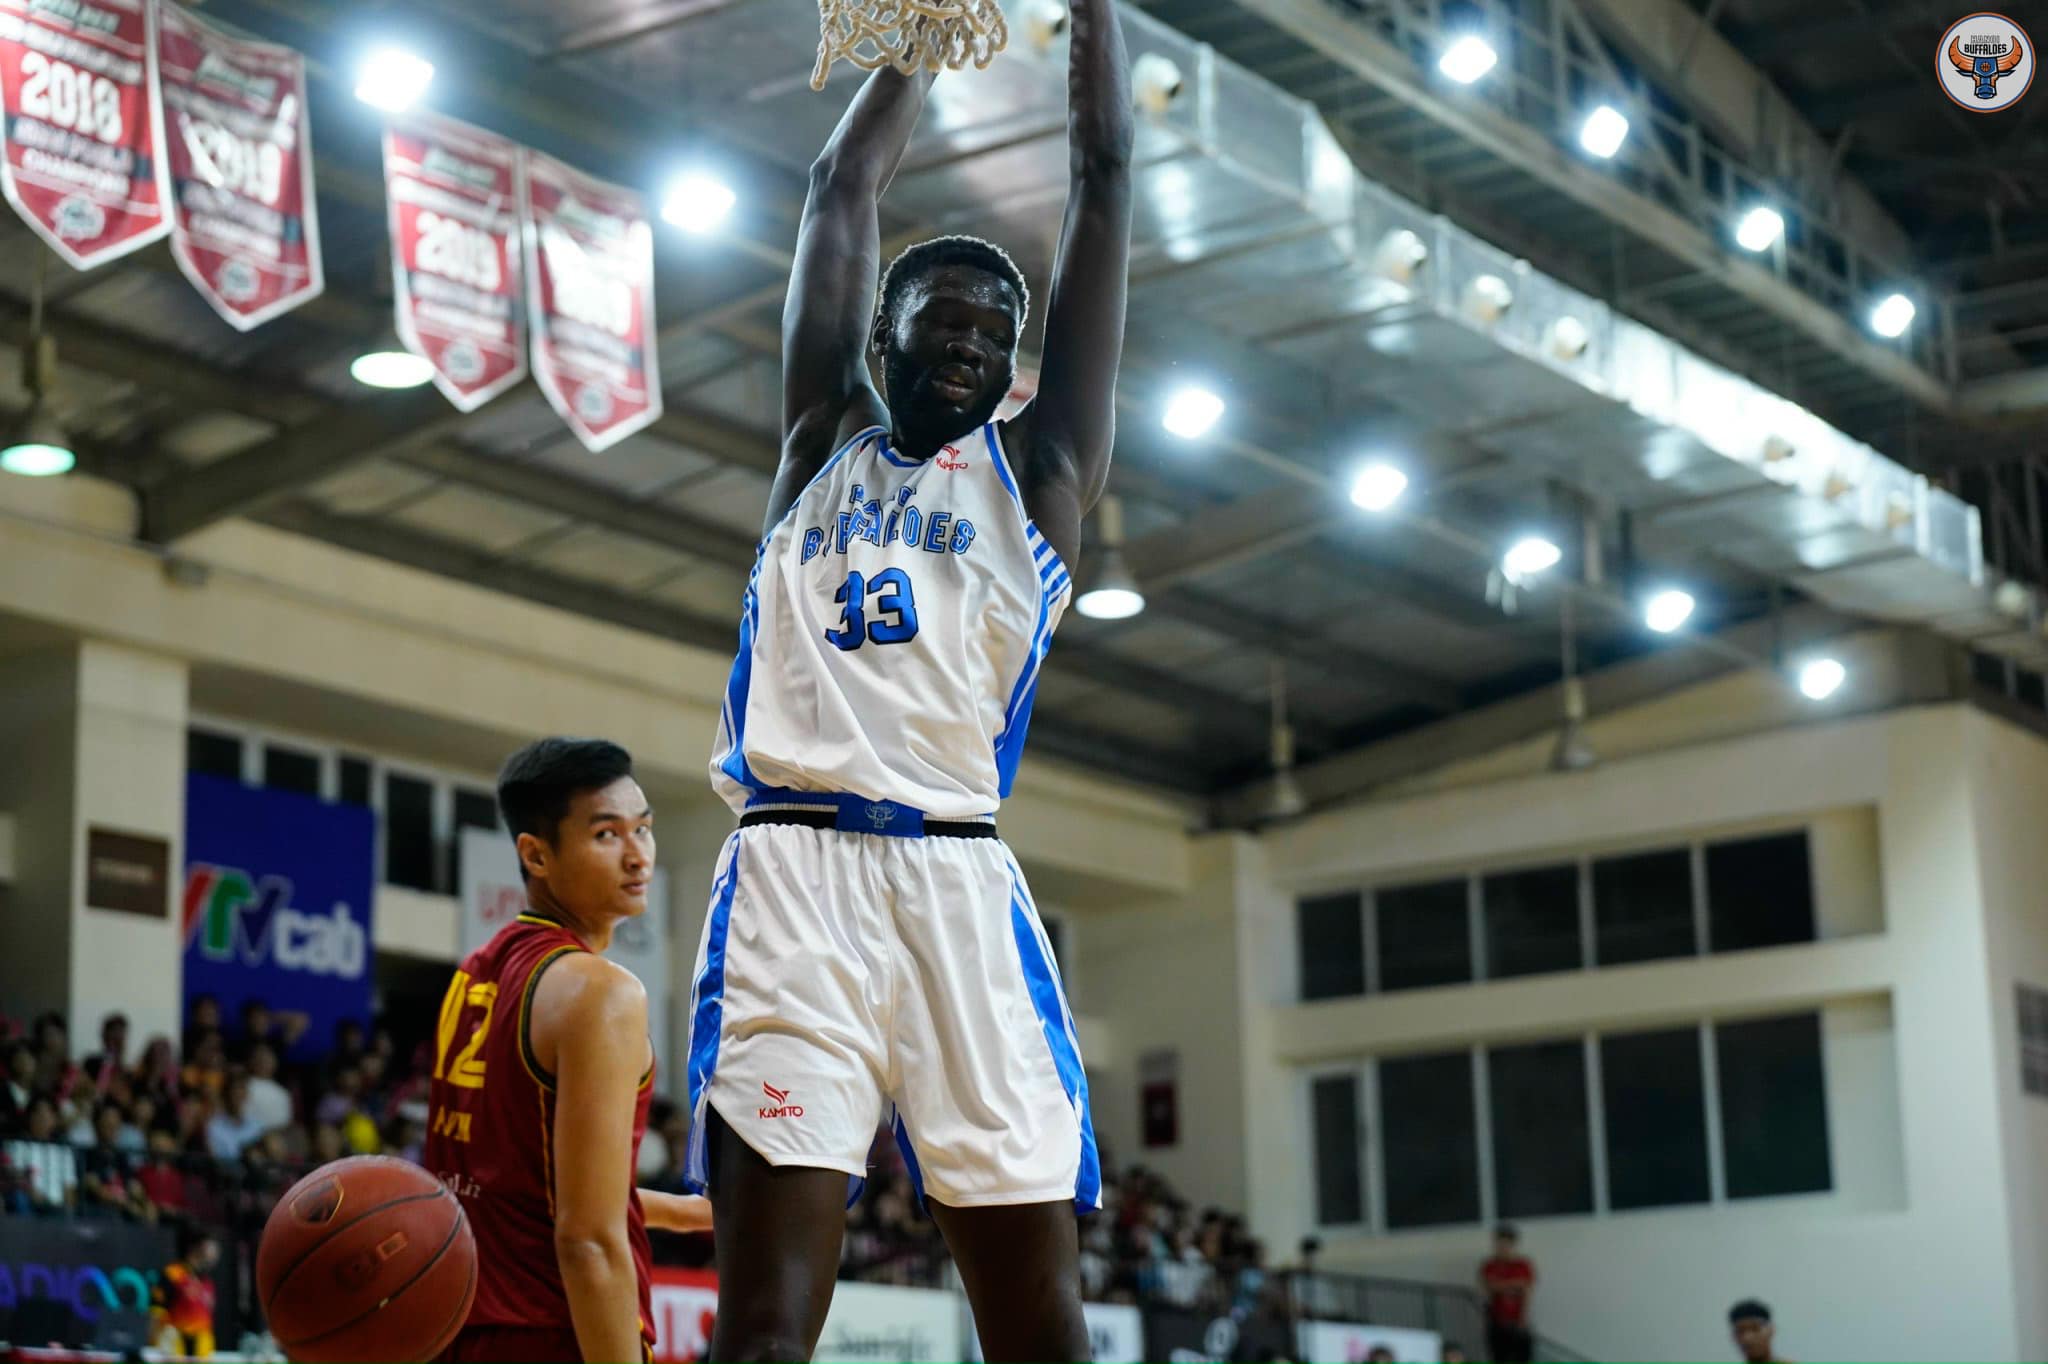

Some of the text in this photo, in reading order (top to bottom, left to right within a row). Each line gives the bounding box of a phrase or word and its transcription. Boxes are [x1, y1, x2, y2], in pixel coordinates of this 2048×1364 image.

[801, 504, 976, 565] BFFALOES
[824, 567, 919, 650] 33
[434, 969, 498, 1089] 12
[759, 1105, 804, 1119] KAMITO
